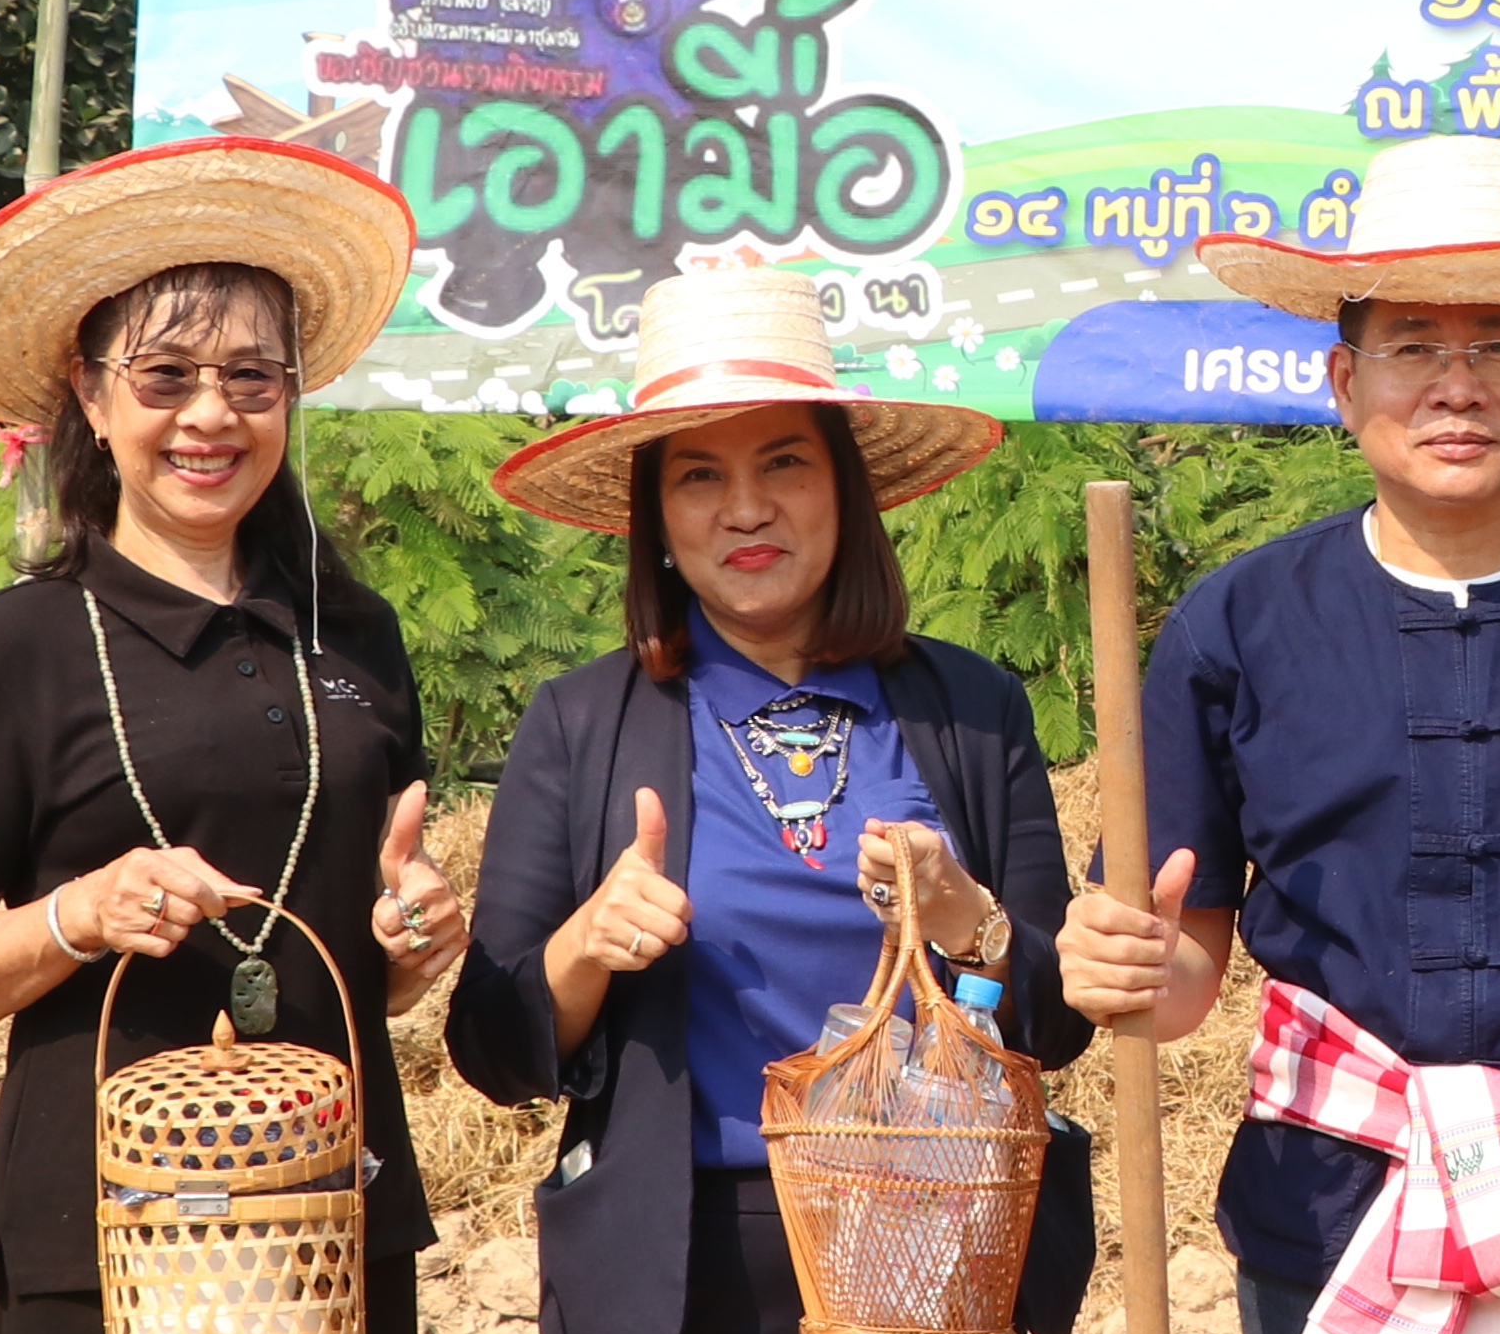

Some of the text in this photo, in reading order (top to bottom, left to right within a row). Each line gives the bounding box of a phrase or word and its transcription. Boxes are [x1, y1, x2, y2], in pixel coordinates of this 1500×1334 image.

[1365, 83, 1427, 130] ณ
[970, 189, 1062, 238] ๑๔
[1089, 158, 1213, 260] หมู่ที่
[1225, 194, 1276, 238] ๖
